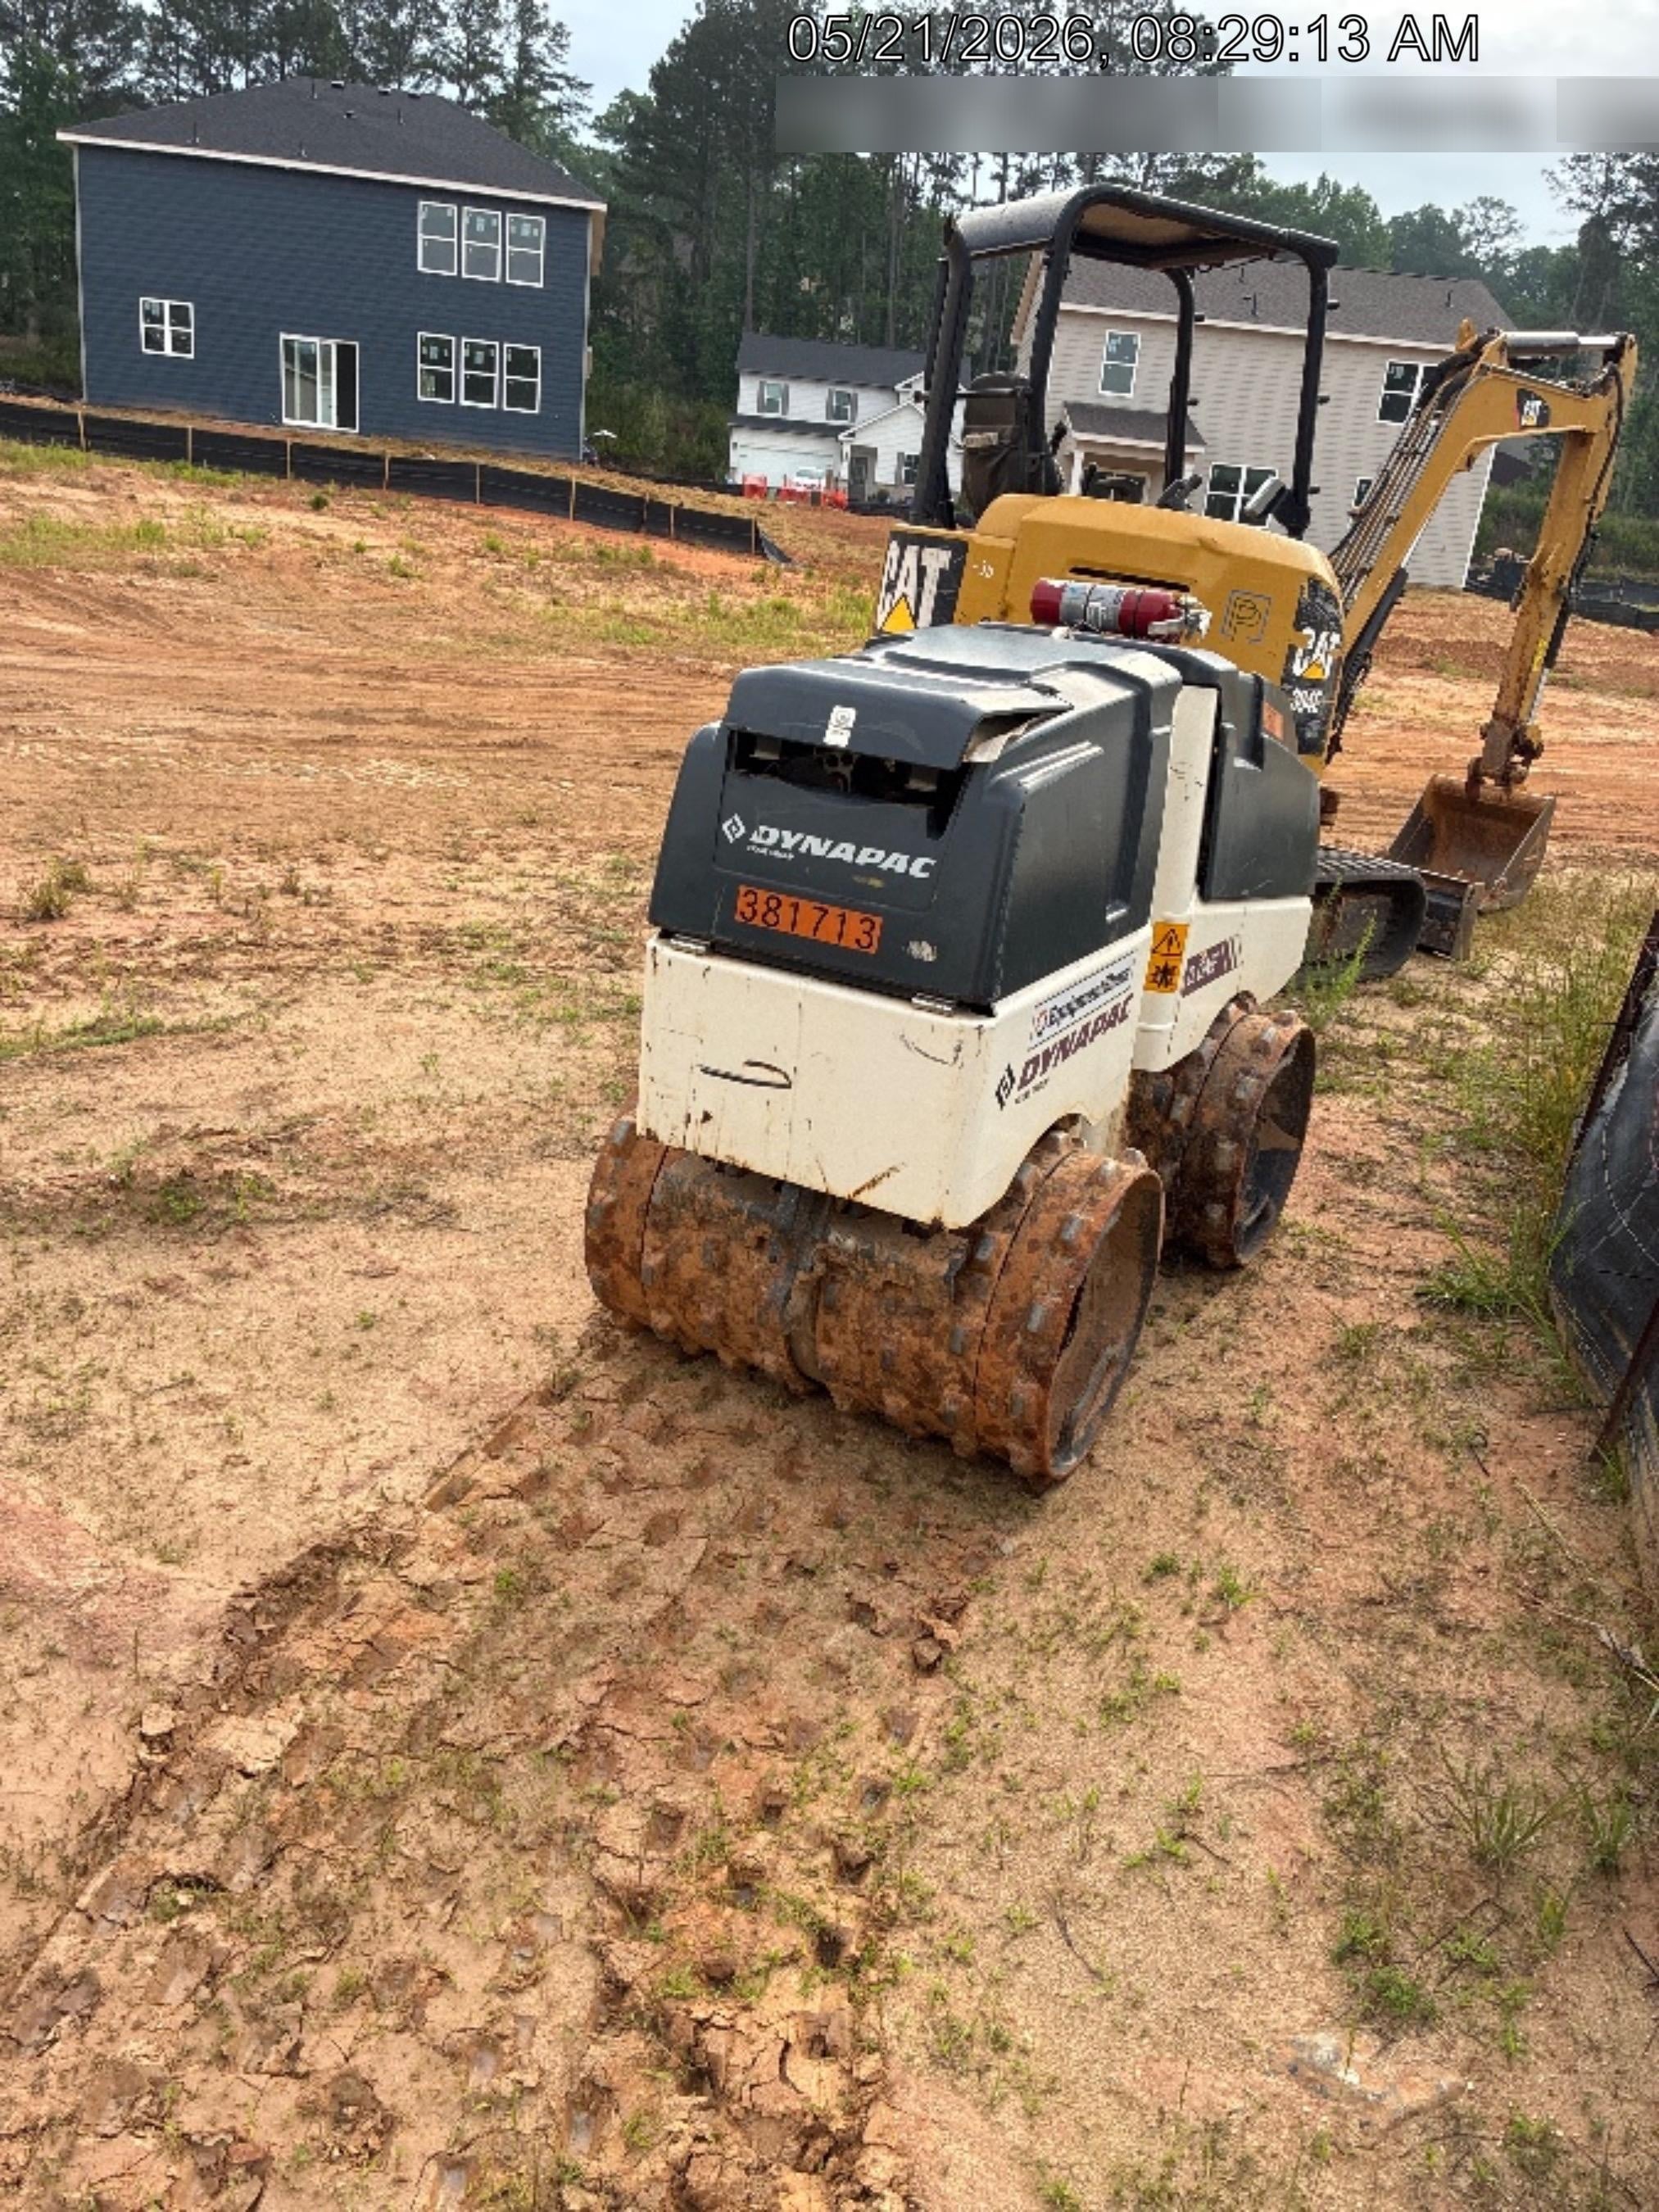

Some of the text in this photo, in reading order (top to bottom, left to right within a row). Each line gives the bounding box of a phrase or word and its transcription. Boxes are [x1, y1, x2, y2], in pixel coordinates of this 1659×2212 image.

[877, 541, 952, 630] CAT
[749, 824, 937, 879] DYNAPAC
[739, 889, 877, 950] 381713
[1017, 992, 1134, 1091] DYNAPAC
